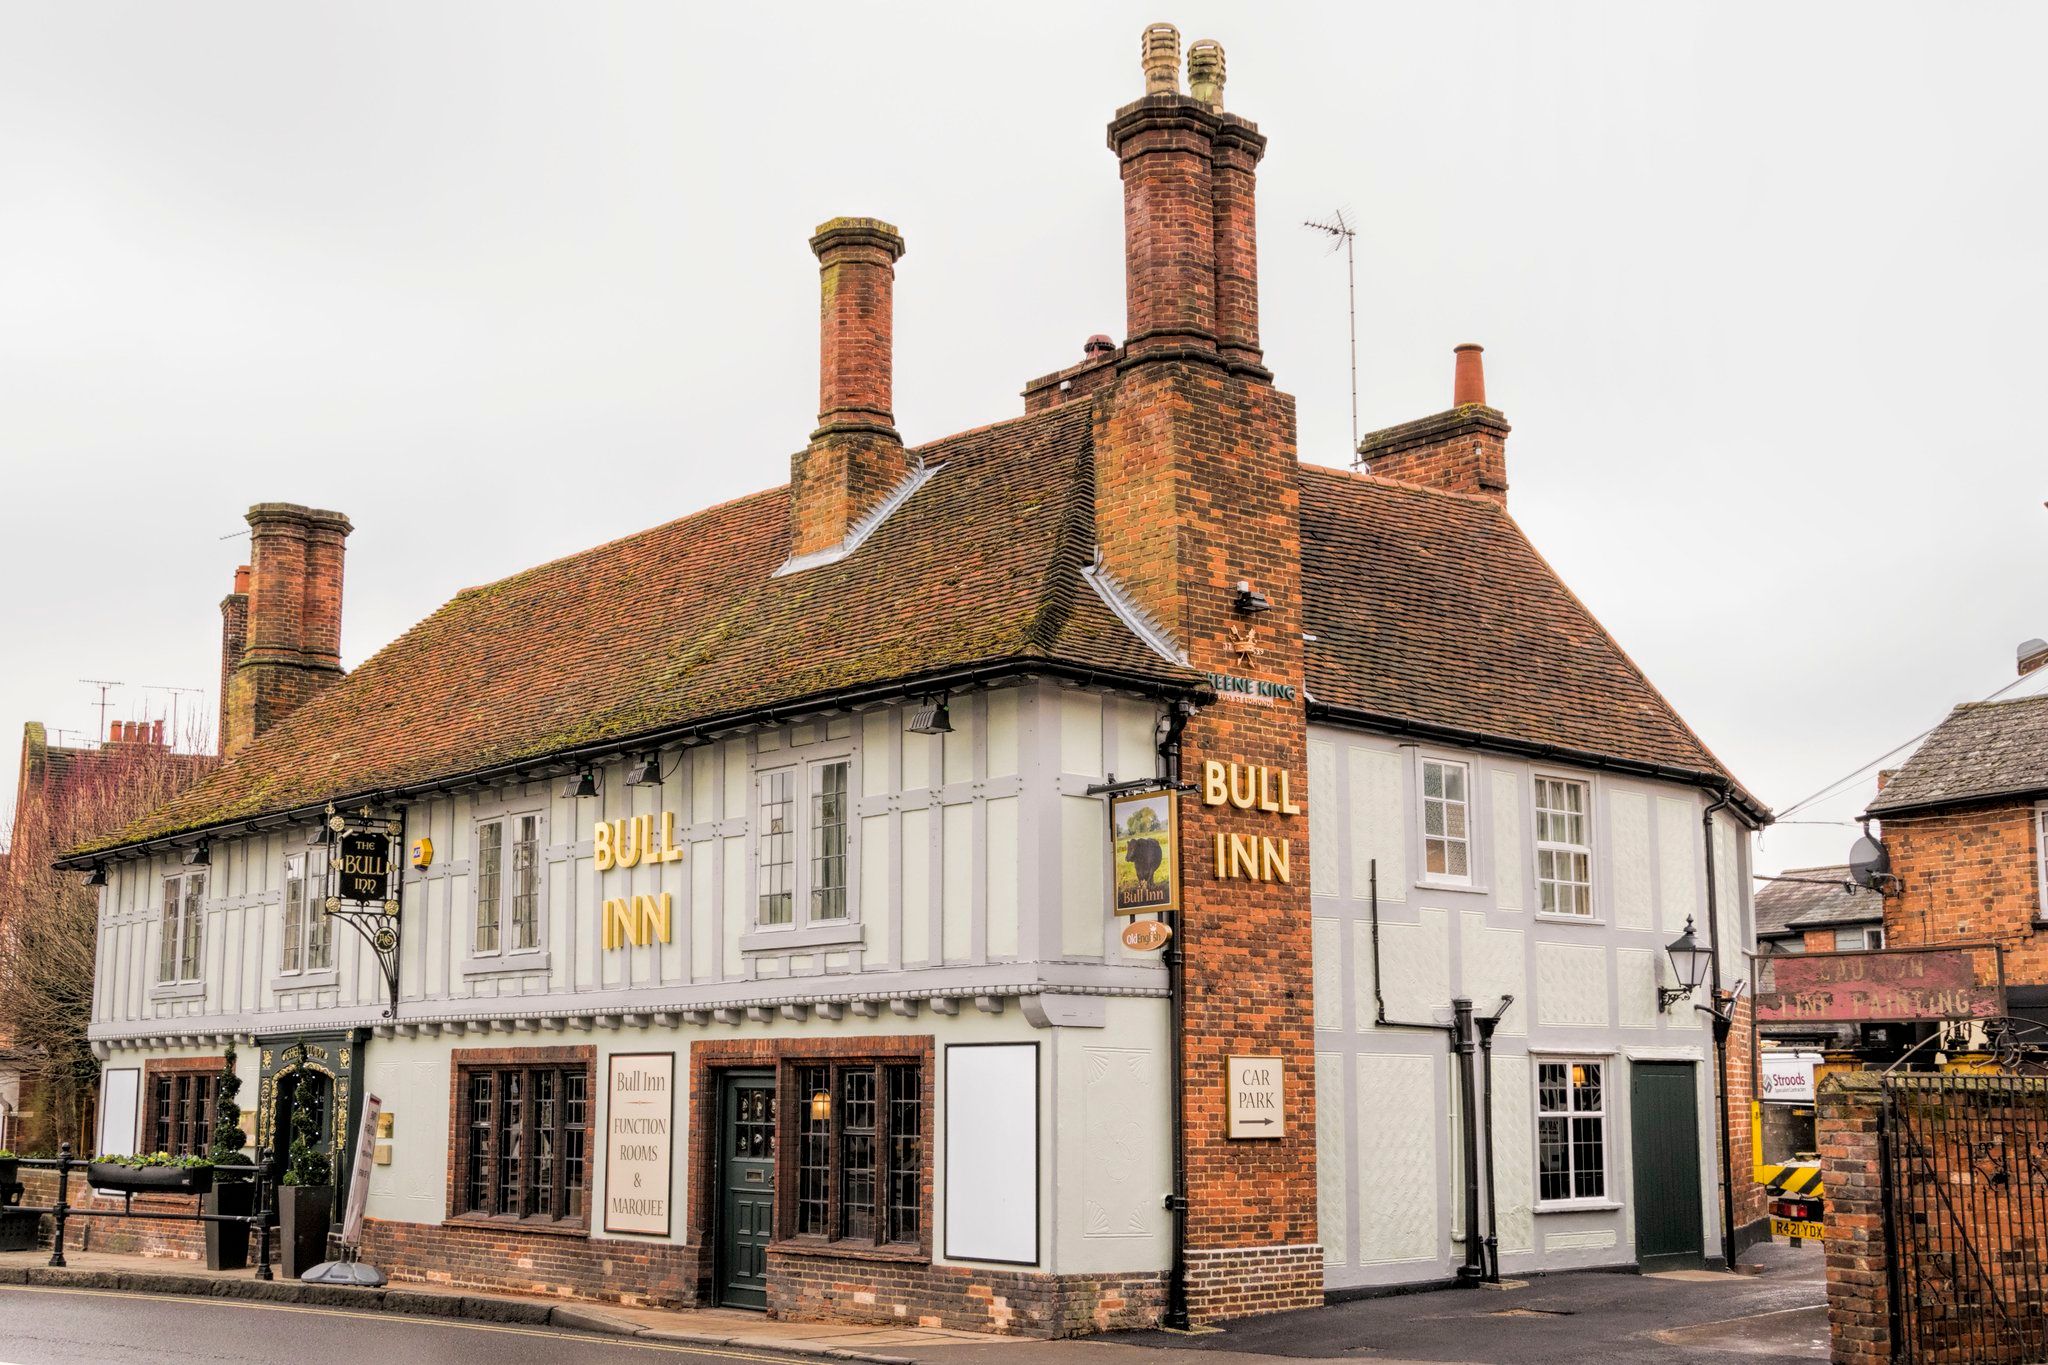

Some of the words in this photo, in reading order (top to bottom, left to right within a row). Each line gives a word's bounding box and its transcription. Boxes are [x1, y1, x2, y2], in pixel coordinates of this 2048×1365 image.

[1206, 671, 1255, 695] REENE
[1257, 681, 1296, 701] KING
[1203, 760, 1300, 815] BULL
[356, 841, 375, 850] THE
[594, 811, 683, 871] BULL
[345, 854, 385, 875] BULL
[1213, 833, 1290, 883] INN
[1123, 888, 1143, 904] Bull
[1146, 888, 1164, 901] Inn
[602, 892, 671, 950] INN
[1852, 988, 1970, 1015] PAINTING
[617, 1071, 640, 1092] Bull
[643, 1071, 665, 1092] Inn
[1242, 1069, 1270, 1086] CAR
[1773, 1073, 1806, 1087] Stroods
[1239, 1092, 1275, 1108] PARK
[614, 1118, 667, 1135] FUNCTION
[620, 1144, 658, 1162] ROOMS
[633, 1172, 642, 1188] &
[612, 1197, 664, 1217] MARQUEE
[1776, 1221, 1800, 1235] R421
[1802, 1224, 1823, 1238] YDX
